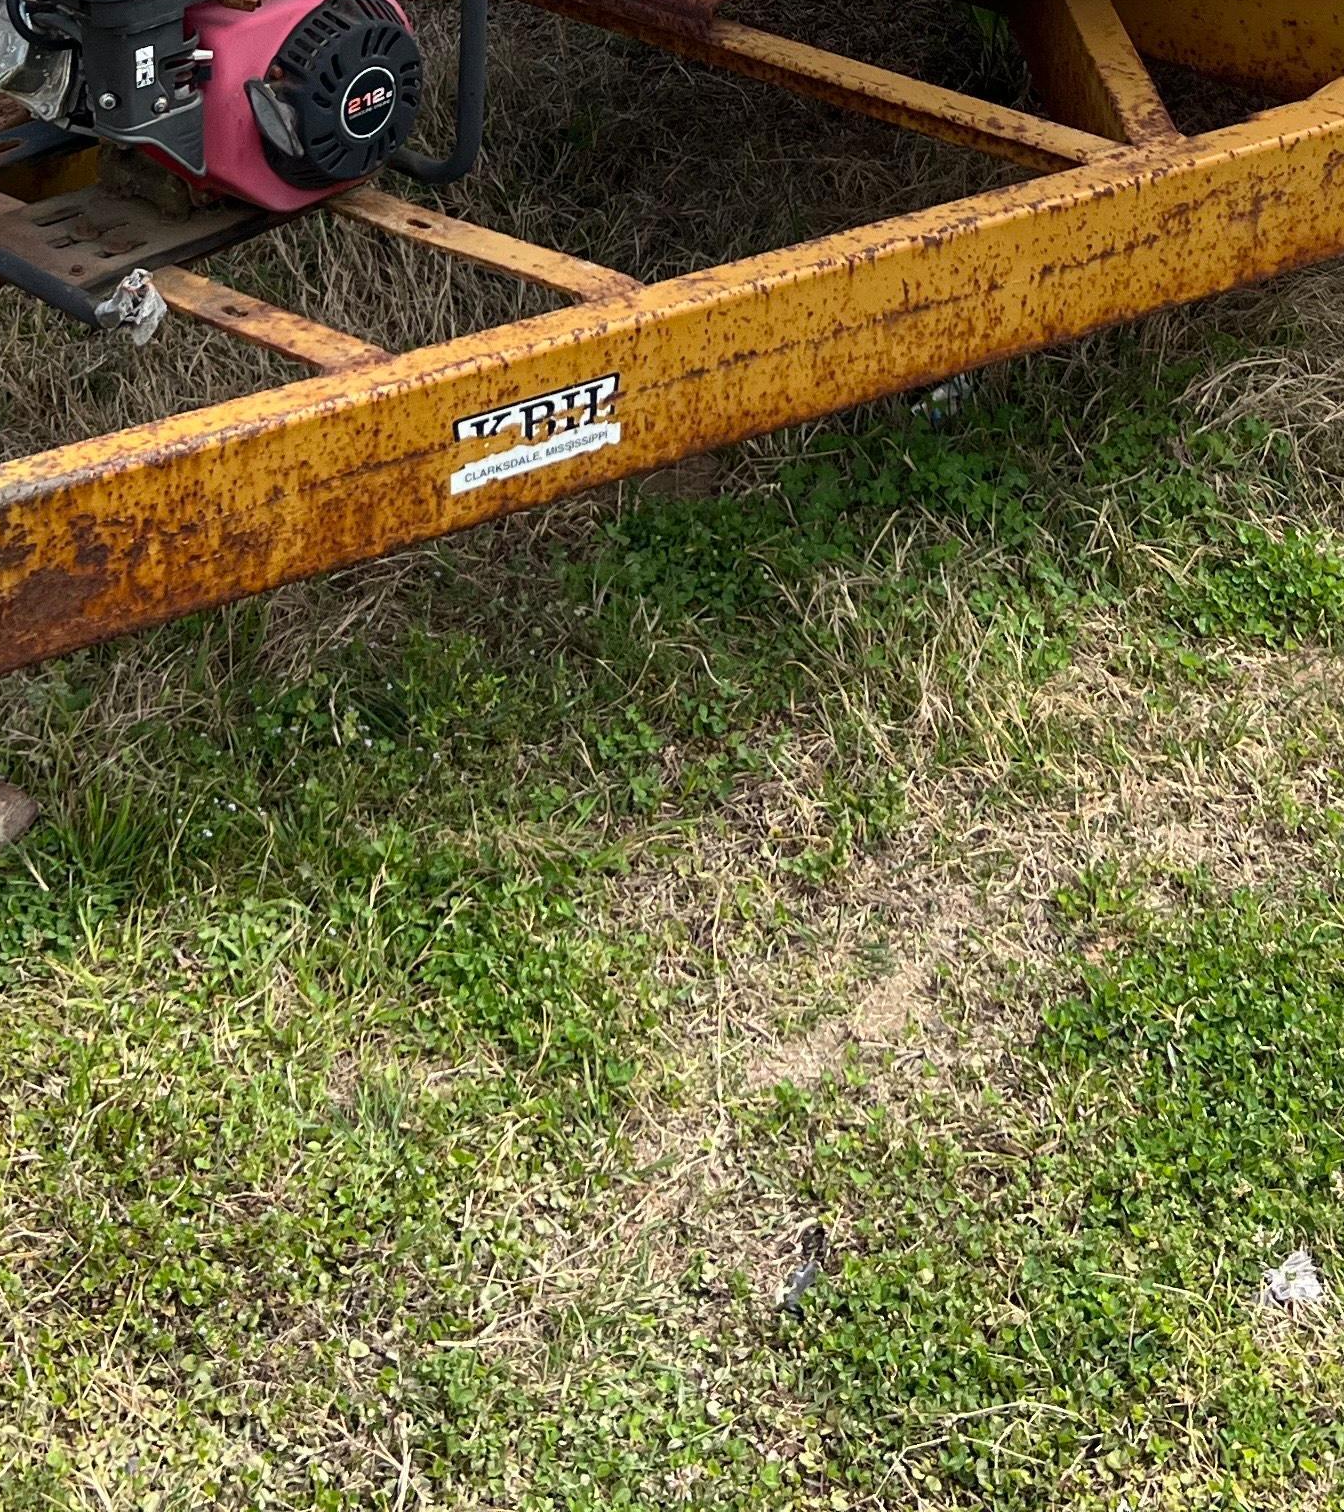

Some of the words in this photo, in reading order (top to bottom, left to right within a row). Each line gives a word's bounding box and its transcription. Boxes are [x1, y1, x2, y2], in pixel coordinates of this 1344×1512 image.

[471, 384, 604, 441] KBH
[464, 451, 544, 483] CLARKSDALE,
[545, 430, 608, 457] MISSISSIPPI
